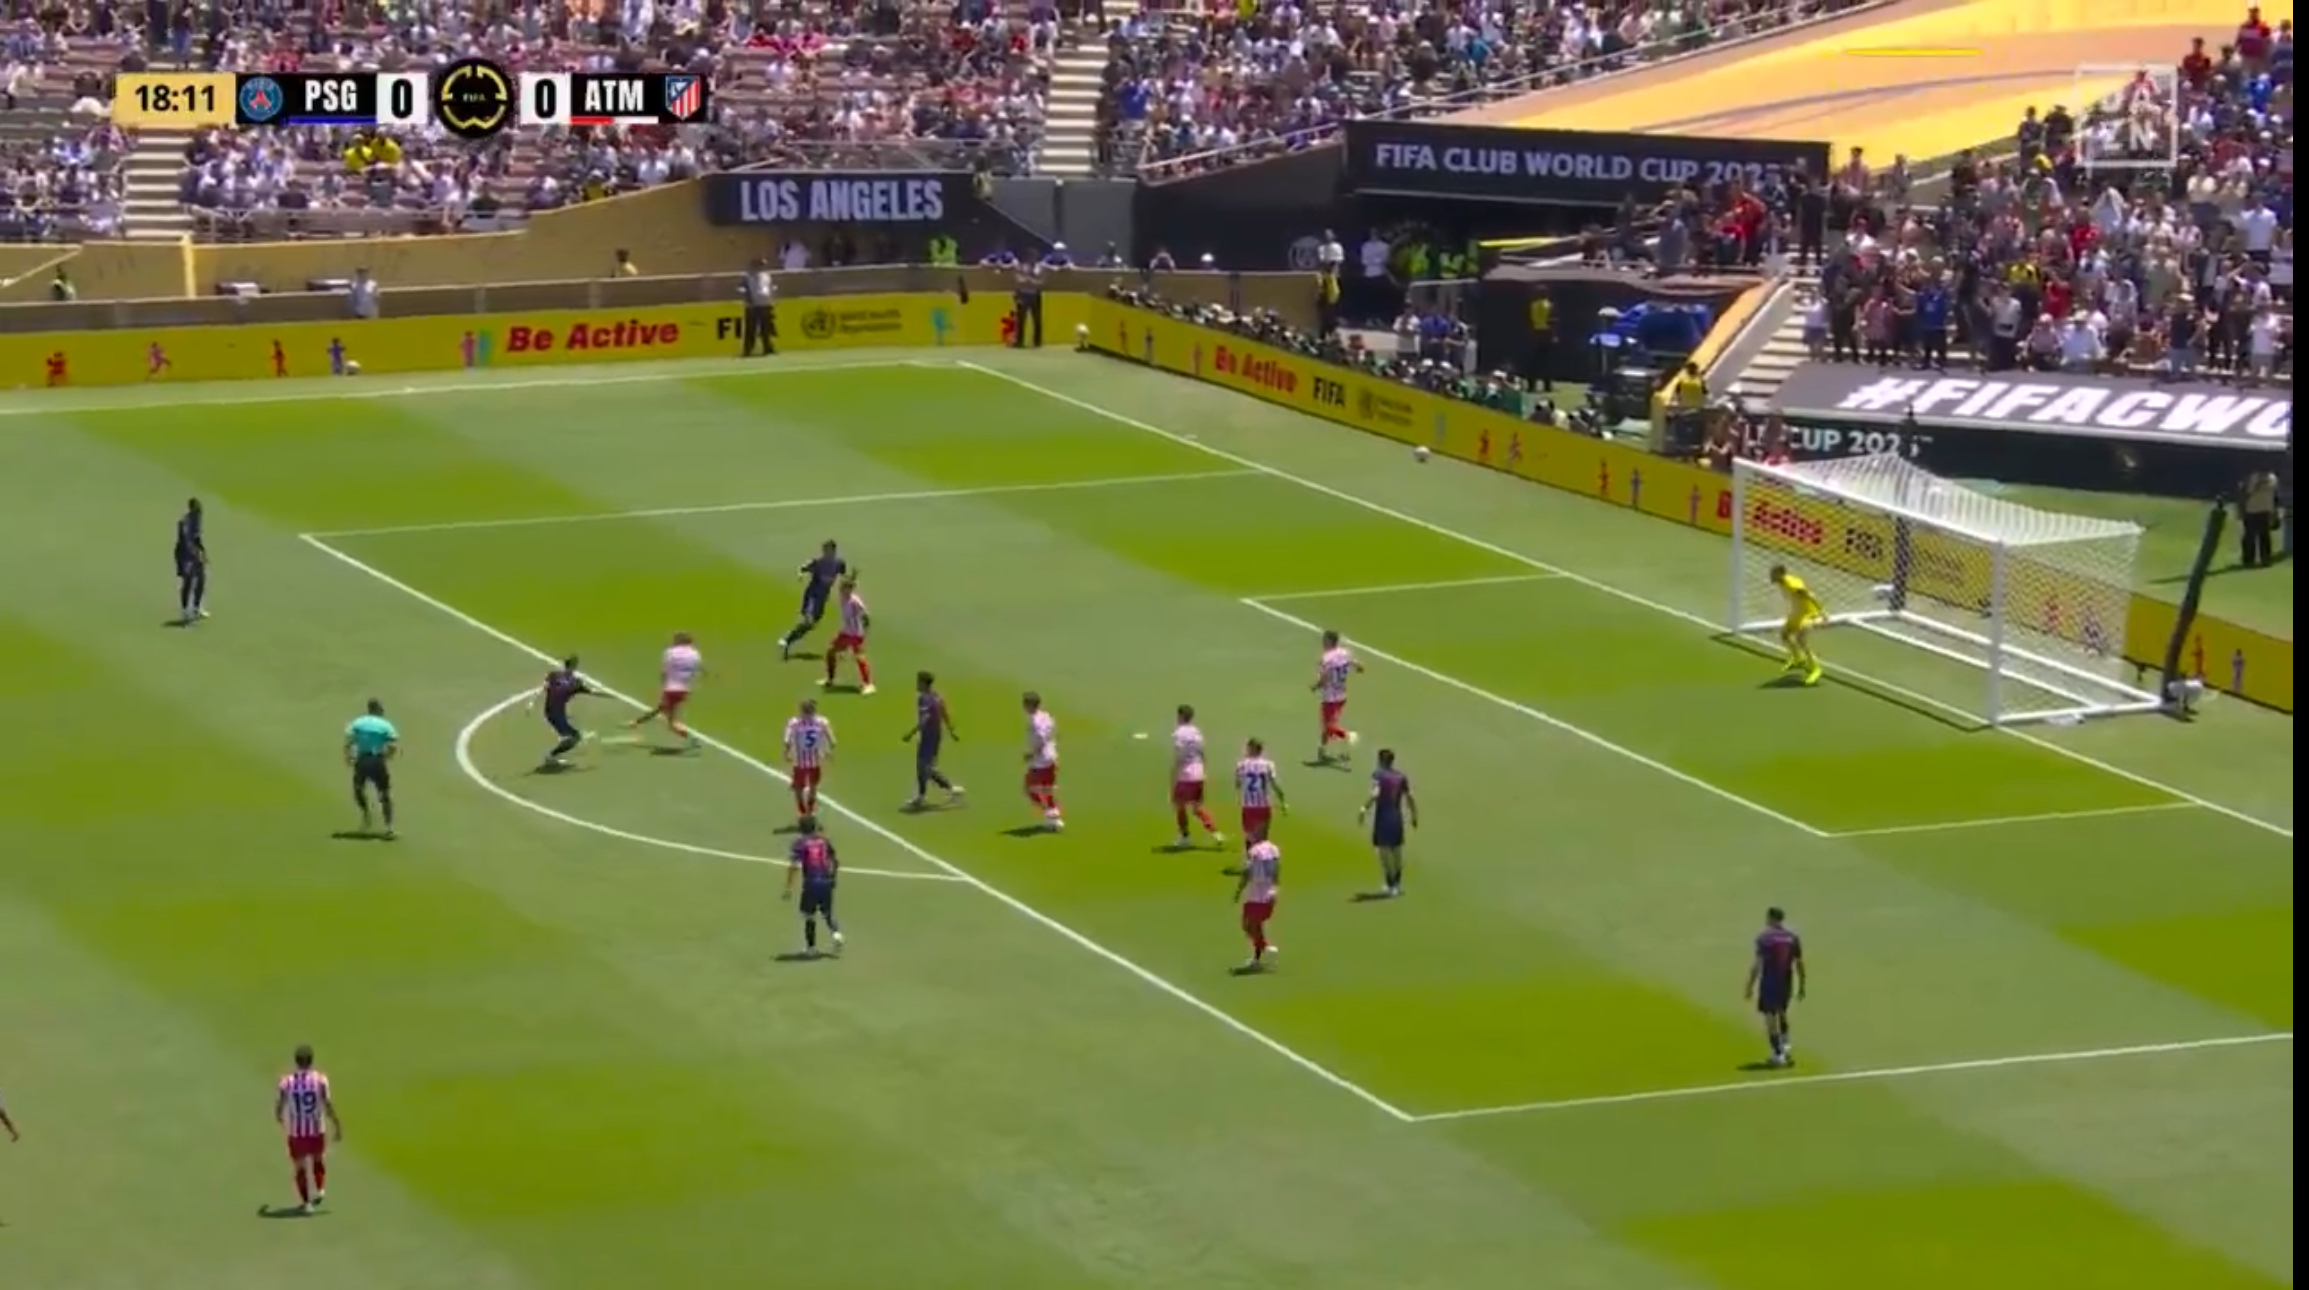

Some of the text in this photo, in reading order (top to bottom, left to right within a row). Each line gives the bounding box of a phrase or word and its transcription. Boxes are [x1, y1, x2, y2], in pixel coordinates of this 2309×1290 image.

[1376, 143, 1437, 171] FIFA
[1443, 147, 1518, 175] CLUB
[1524, 152, 1633, 180] WORLD
[1639, 157, 1700, 182] CUP
[740, 179, 943, 221] LOS ANGELES
[507, 318, 680, 352] Be Active
[1313, 376, 1345, 407] FIFA
[804, 729, 816, 749] 5
[1246, 771, 1266, 792] 21
[292, 1090, 317, 1114] 19
